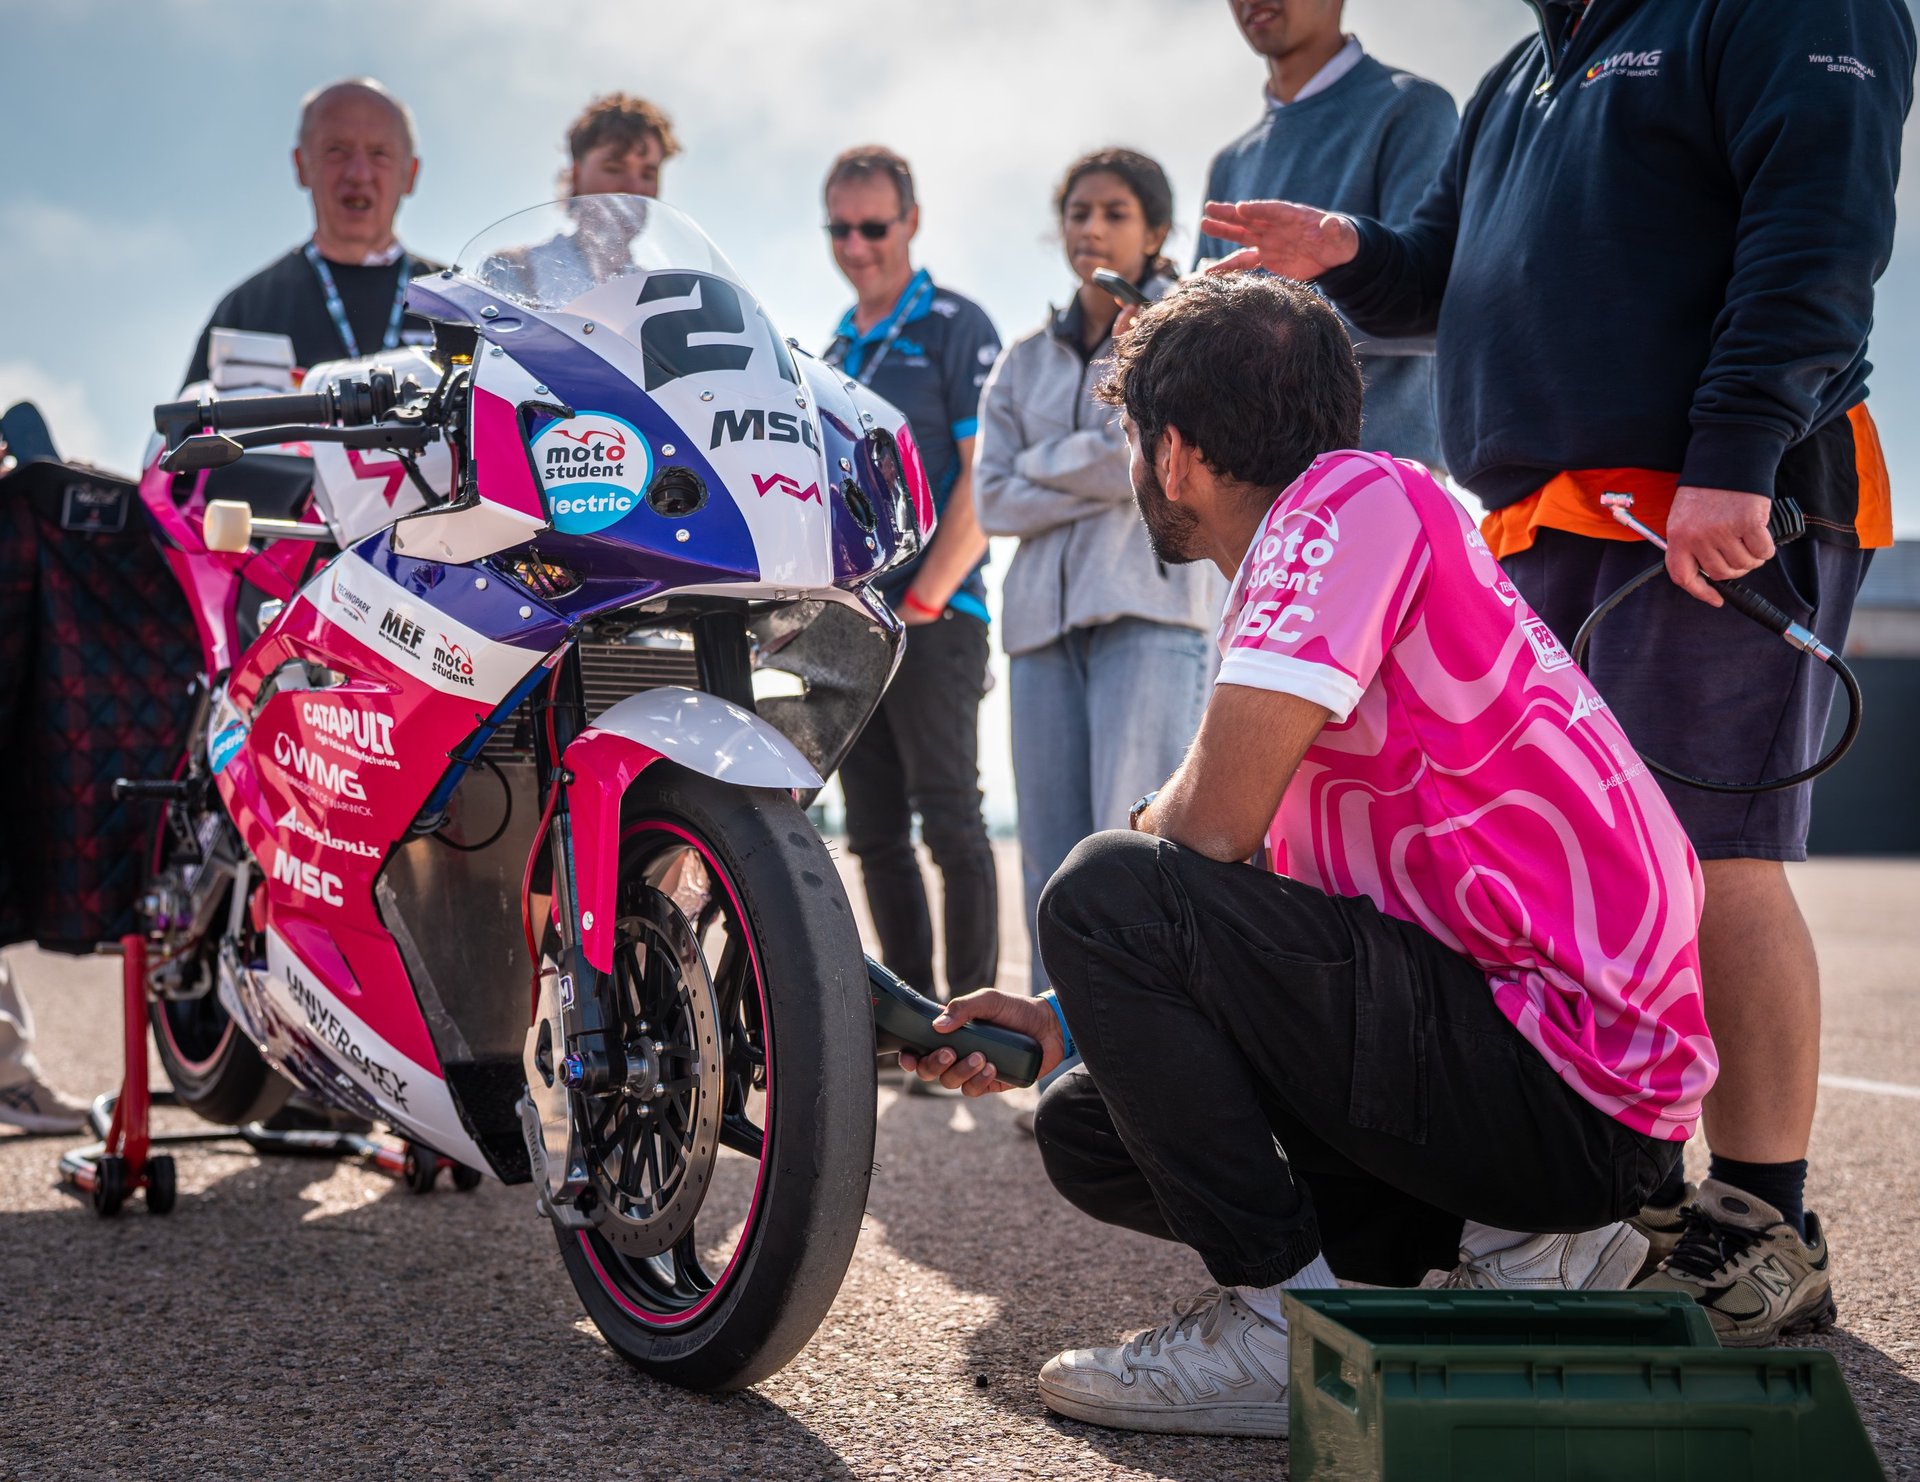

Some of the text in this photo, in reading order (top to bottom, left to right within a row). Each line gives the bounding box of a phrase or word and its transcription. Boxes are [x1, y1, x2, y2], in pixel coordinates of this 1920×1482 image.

[1603, 50, 1662, 70] WMG
[1808, 54, 1833, 63] WMG
[547, 442, 625, 464] moto
[545, 463, 623, 479] student
[549, 492, 631, 515] lectric
[336, 583, 372, 615] TECHNOPARK
[380, 608, 426, 650] MEF
[432, 662, 475, 687] student
[434, 647, 474, 675] moto
[303, 702, 396, 756] CATAPULT
[289, 738, 368, 801] WMG
[276, 806, 381, 859] Accelonix
[272, 847, 344, 908] MSC
[286, 965, 409, 1094] UNIVERSITY
